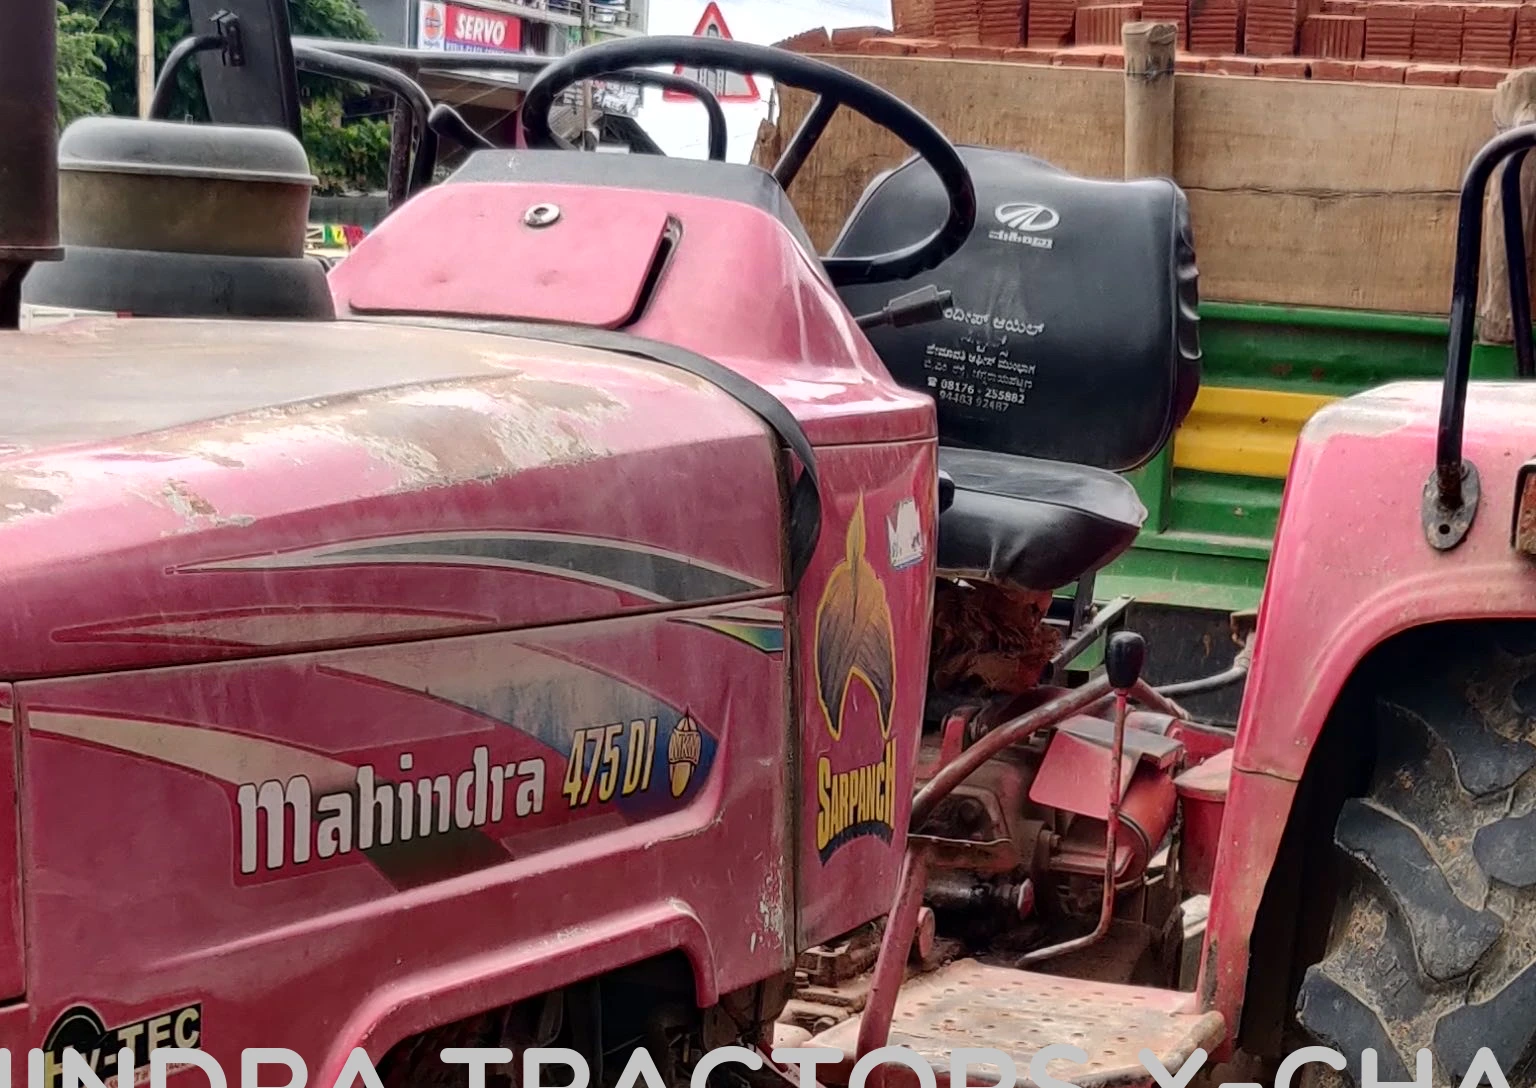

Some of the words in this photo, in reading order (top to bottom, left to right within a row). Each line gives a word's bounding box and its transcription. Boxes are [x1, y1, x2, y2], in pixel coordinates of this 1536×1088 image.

[455, 13, 506, 46] SERVO
[940, 378, 975, 394] 08176
[984, 388, 1026, 405] 255882
[236, 743, 547, 875] Mahindra
[560, 722, 623, 810] 475
[620, 716, 659, 799] DI
